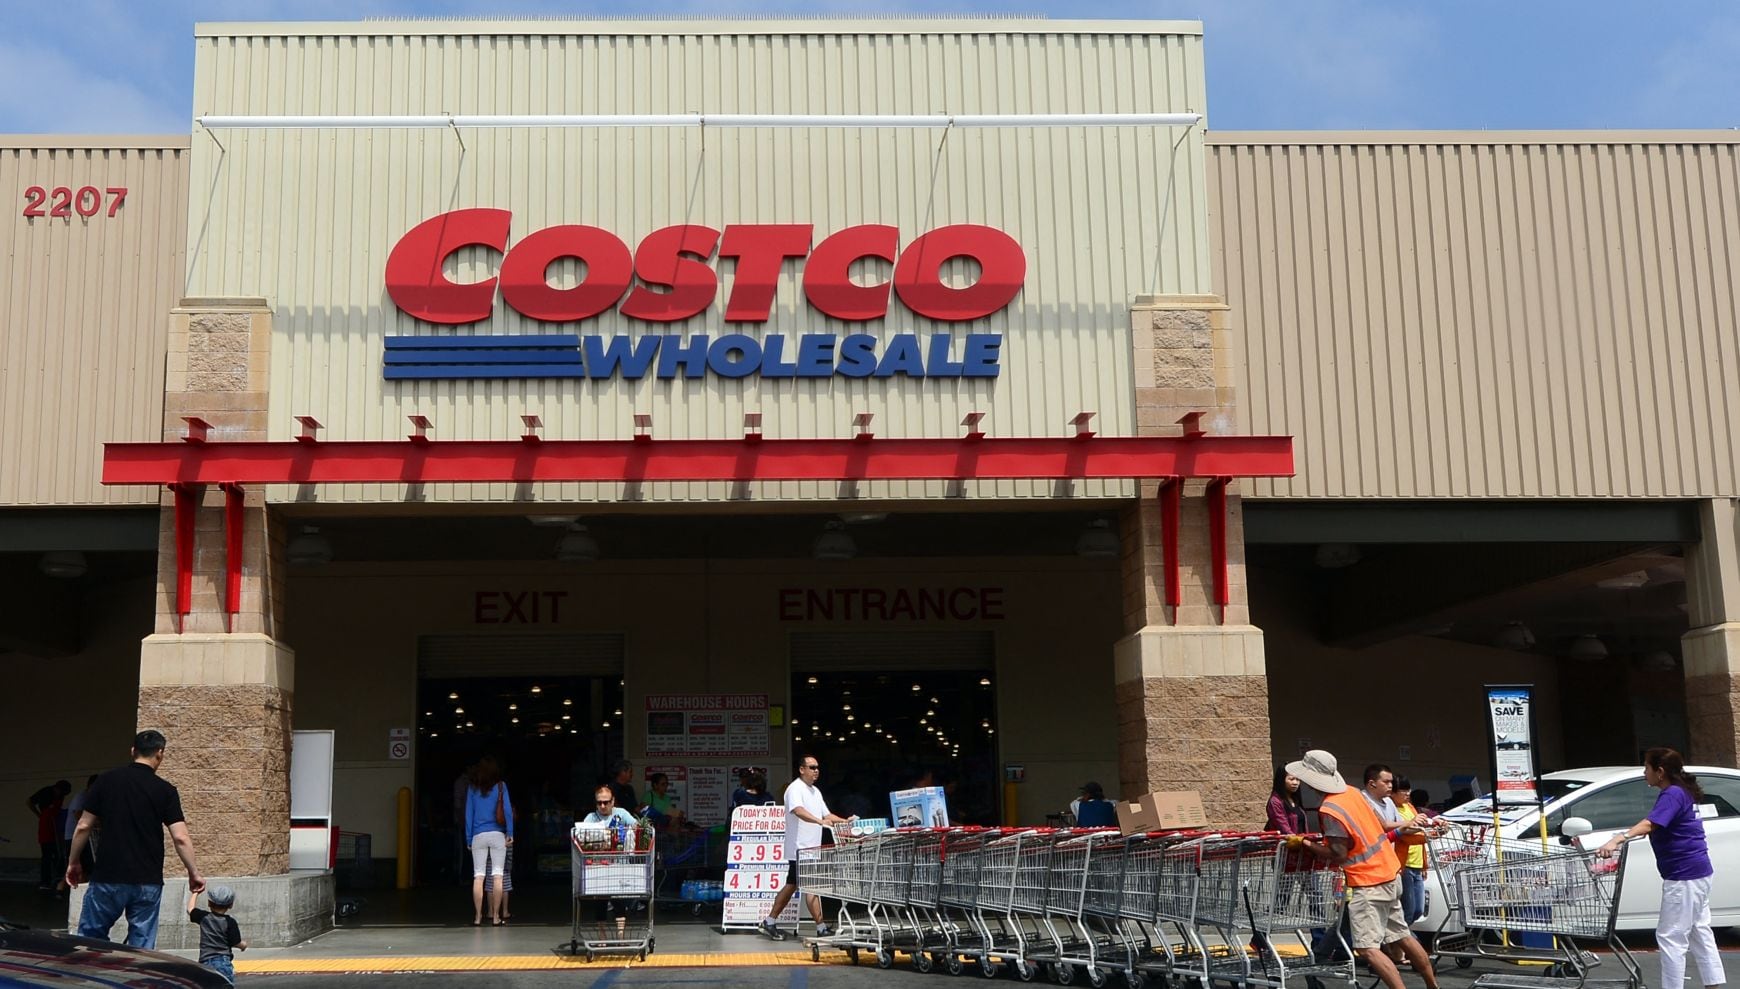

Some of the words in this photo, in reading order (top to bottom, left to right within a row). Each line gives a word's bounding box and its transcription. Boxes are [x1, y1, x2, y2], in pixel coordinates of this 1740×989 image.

[23, 186, 128, 217] 2207
[385, 207, 1026, 325] COSTCO
[582, 333, 1003, 379] WHOLESALE
[476, 592, 568, 623] EXIT
[779, 588, 1005, 621] ENTRANCE
[649, 696, 722, 709] WAREHOUSE
[726, 696, 765, 708] HOURS
[1495, 707, 1524, 716] SAVE
[732, 820, 753, 830] PRICE
[755, 820, 769, 830] FOR
[739, 807, 767, 818] TODAY'S
